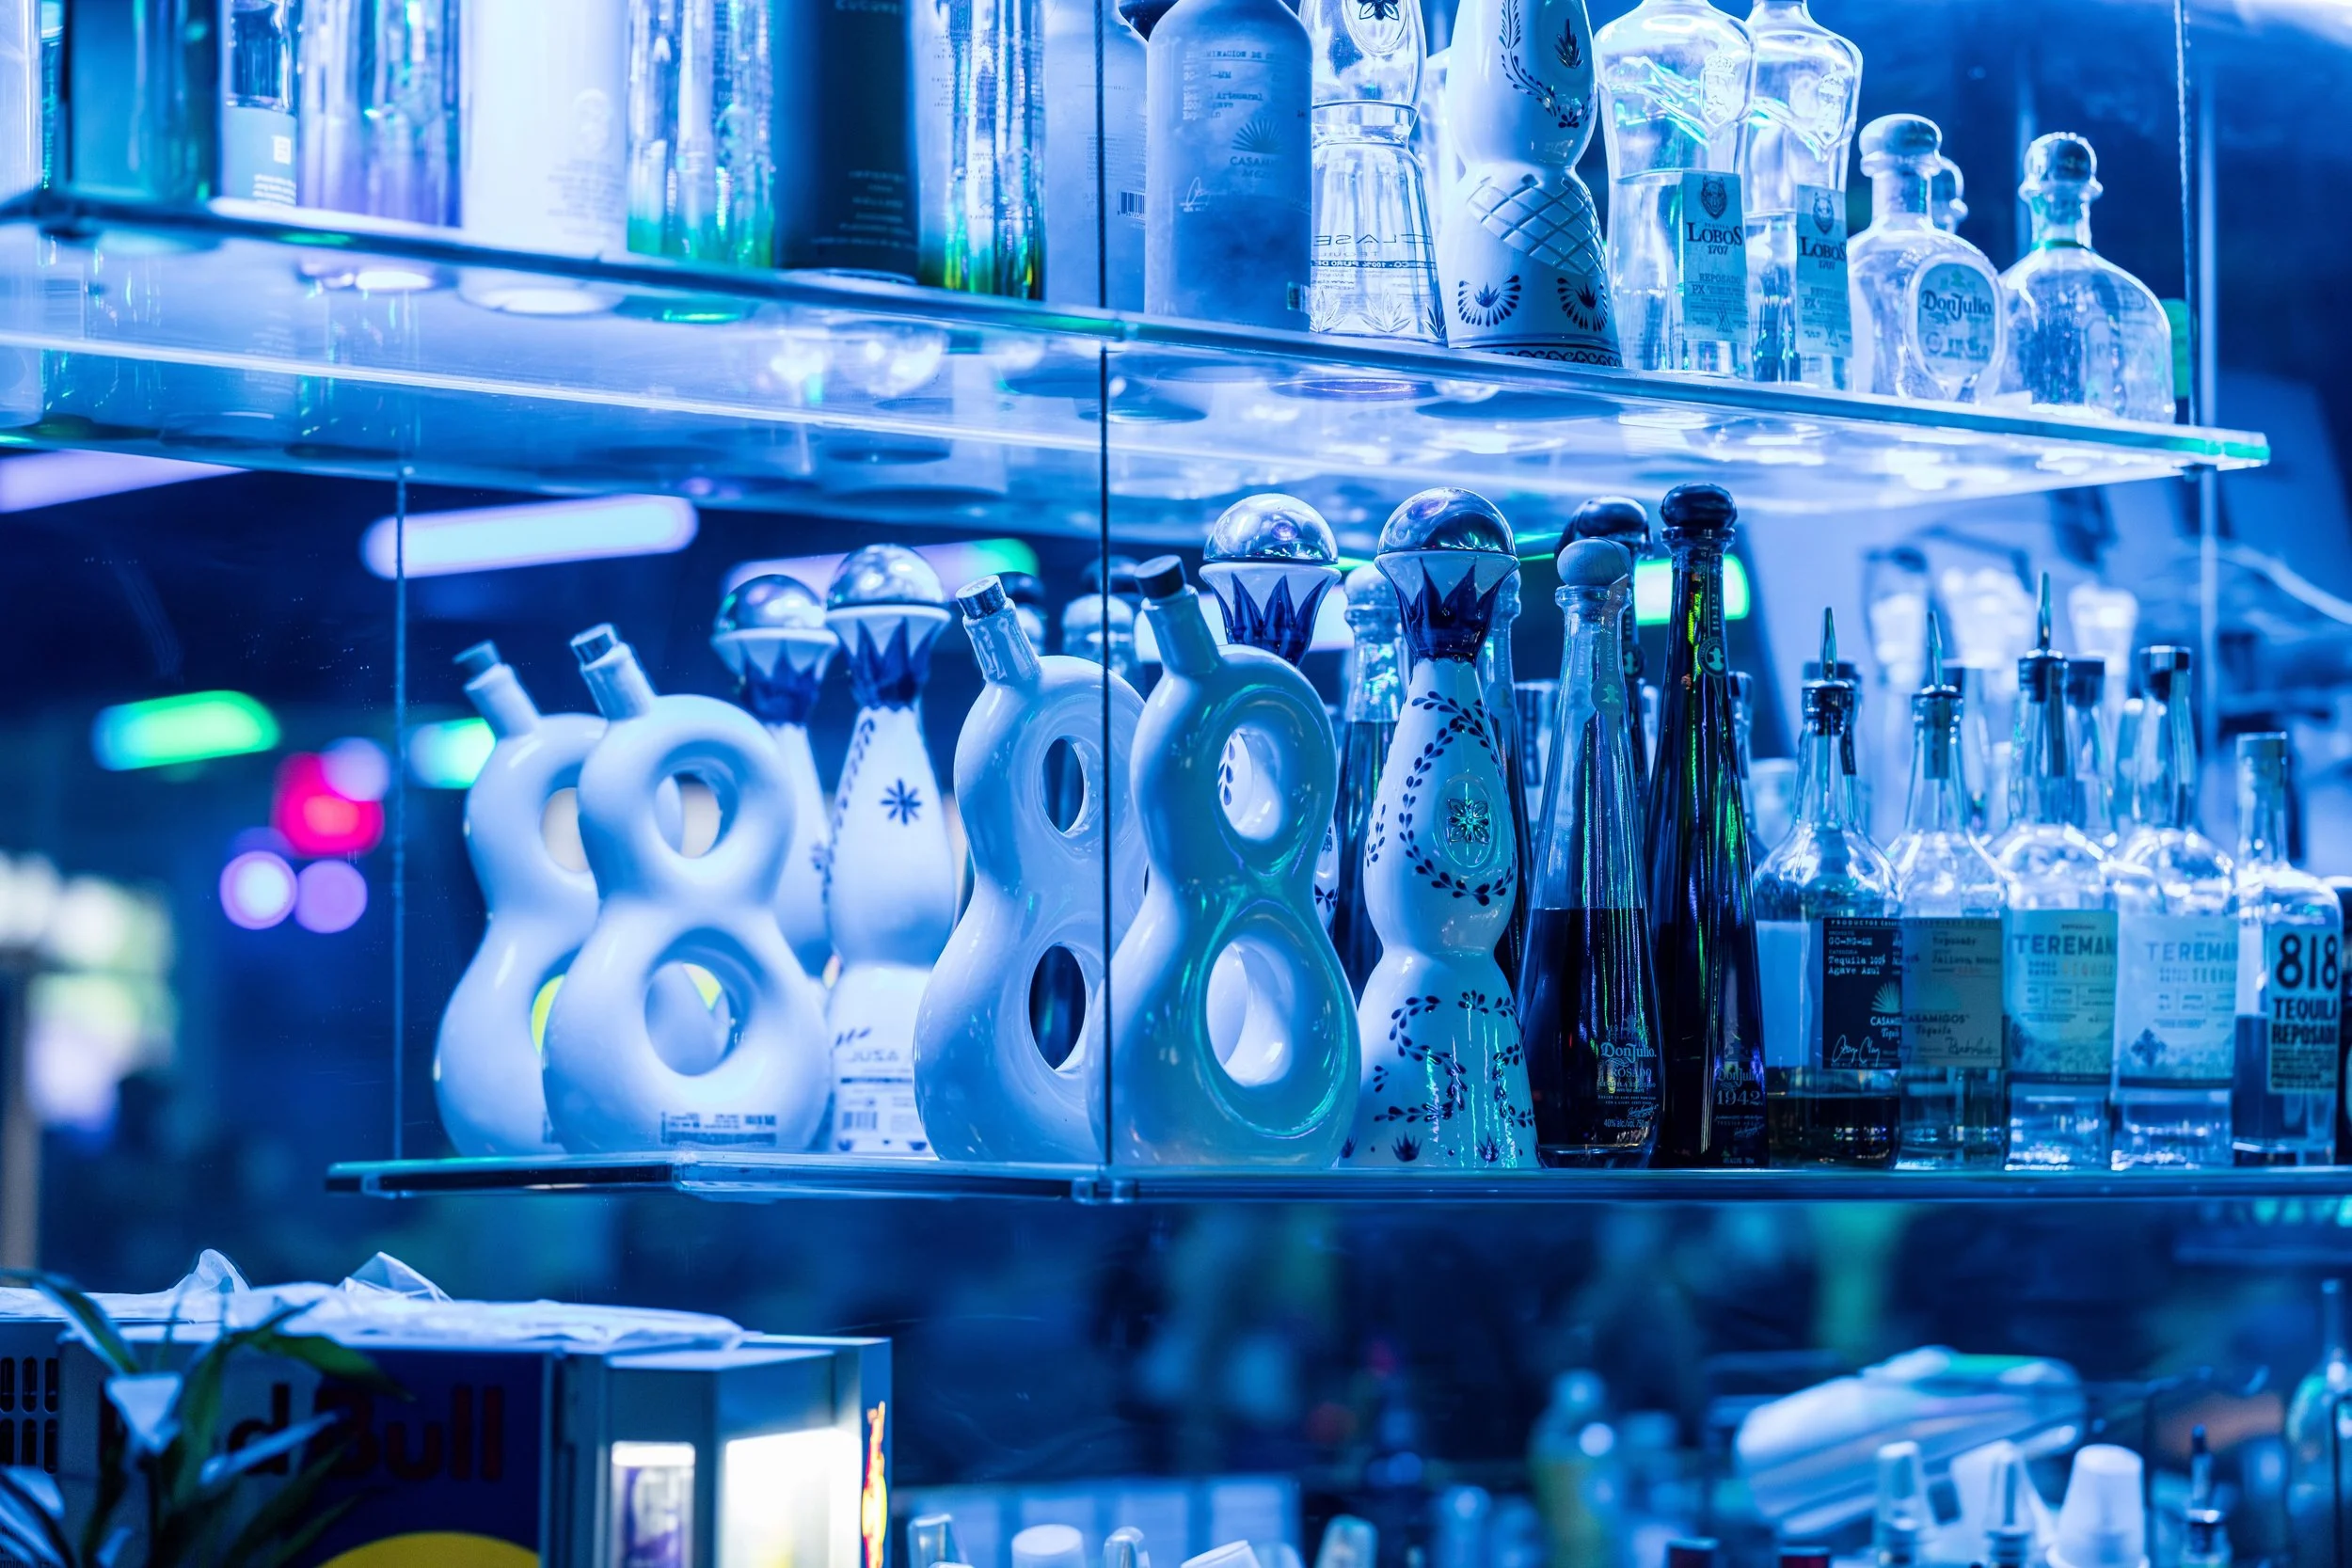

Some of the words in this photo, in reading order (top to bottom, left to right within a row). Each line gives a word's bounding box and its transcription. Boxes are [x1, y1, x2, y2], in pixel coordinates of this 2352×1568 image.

[1687, 222, 1742, 246] LOBOS
[1708, 245, 1728, 256] 1707
[1800, 236, 1846, 261] LOBOS
[2275, 931, 2339, 990] 818
